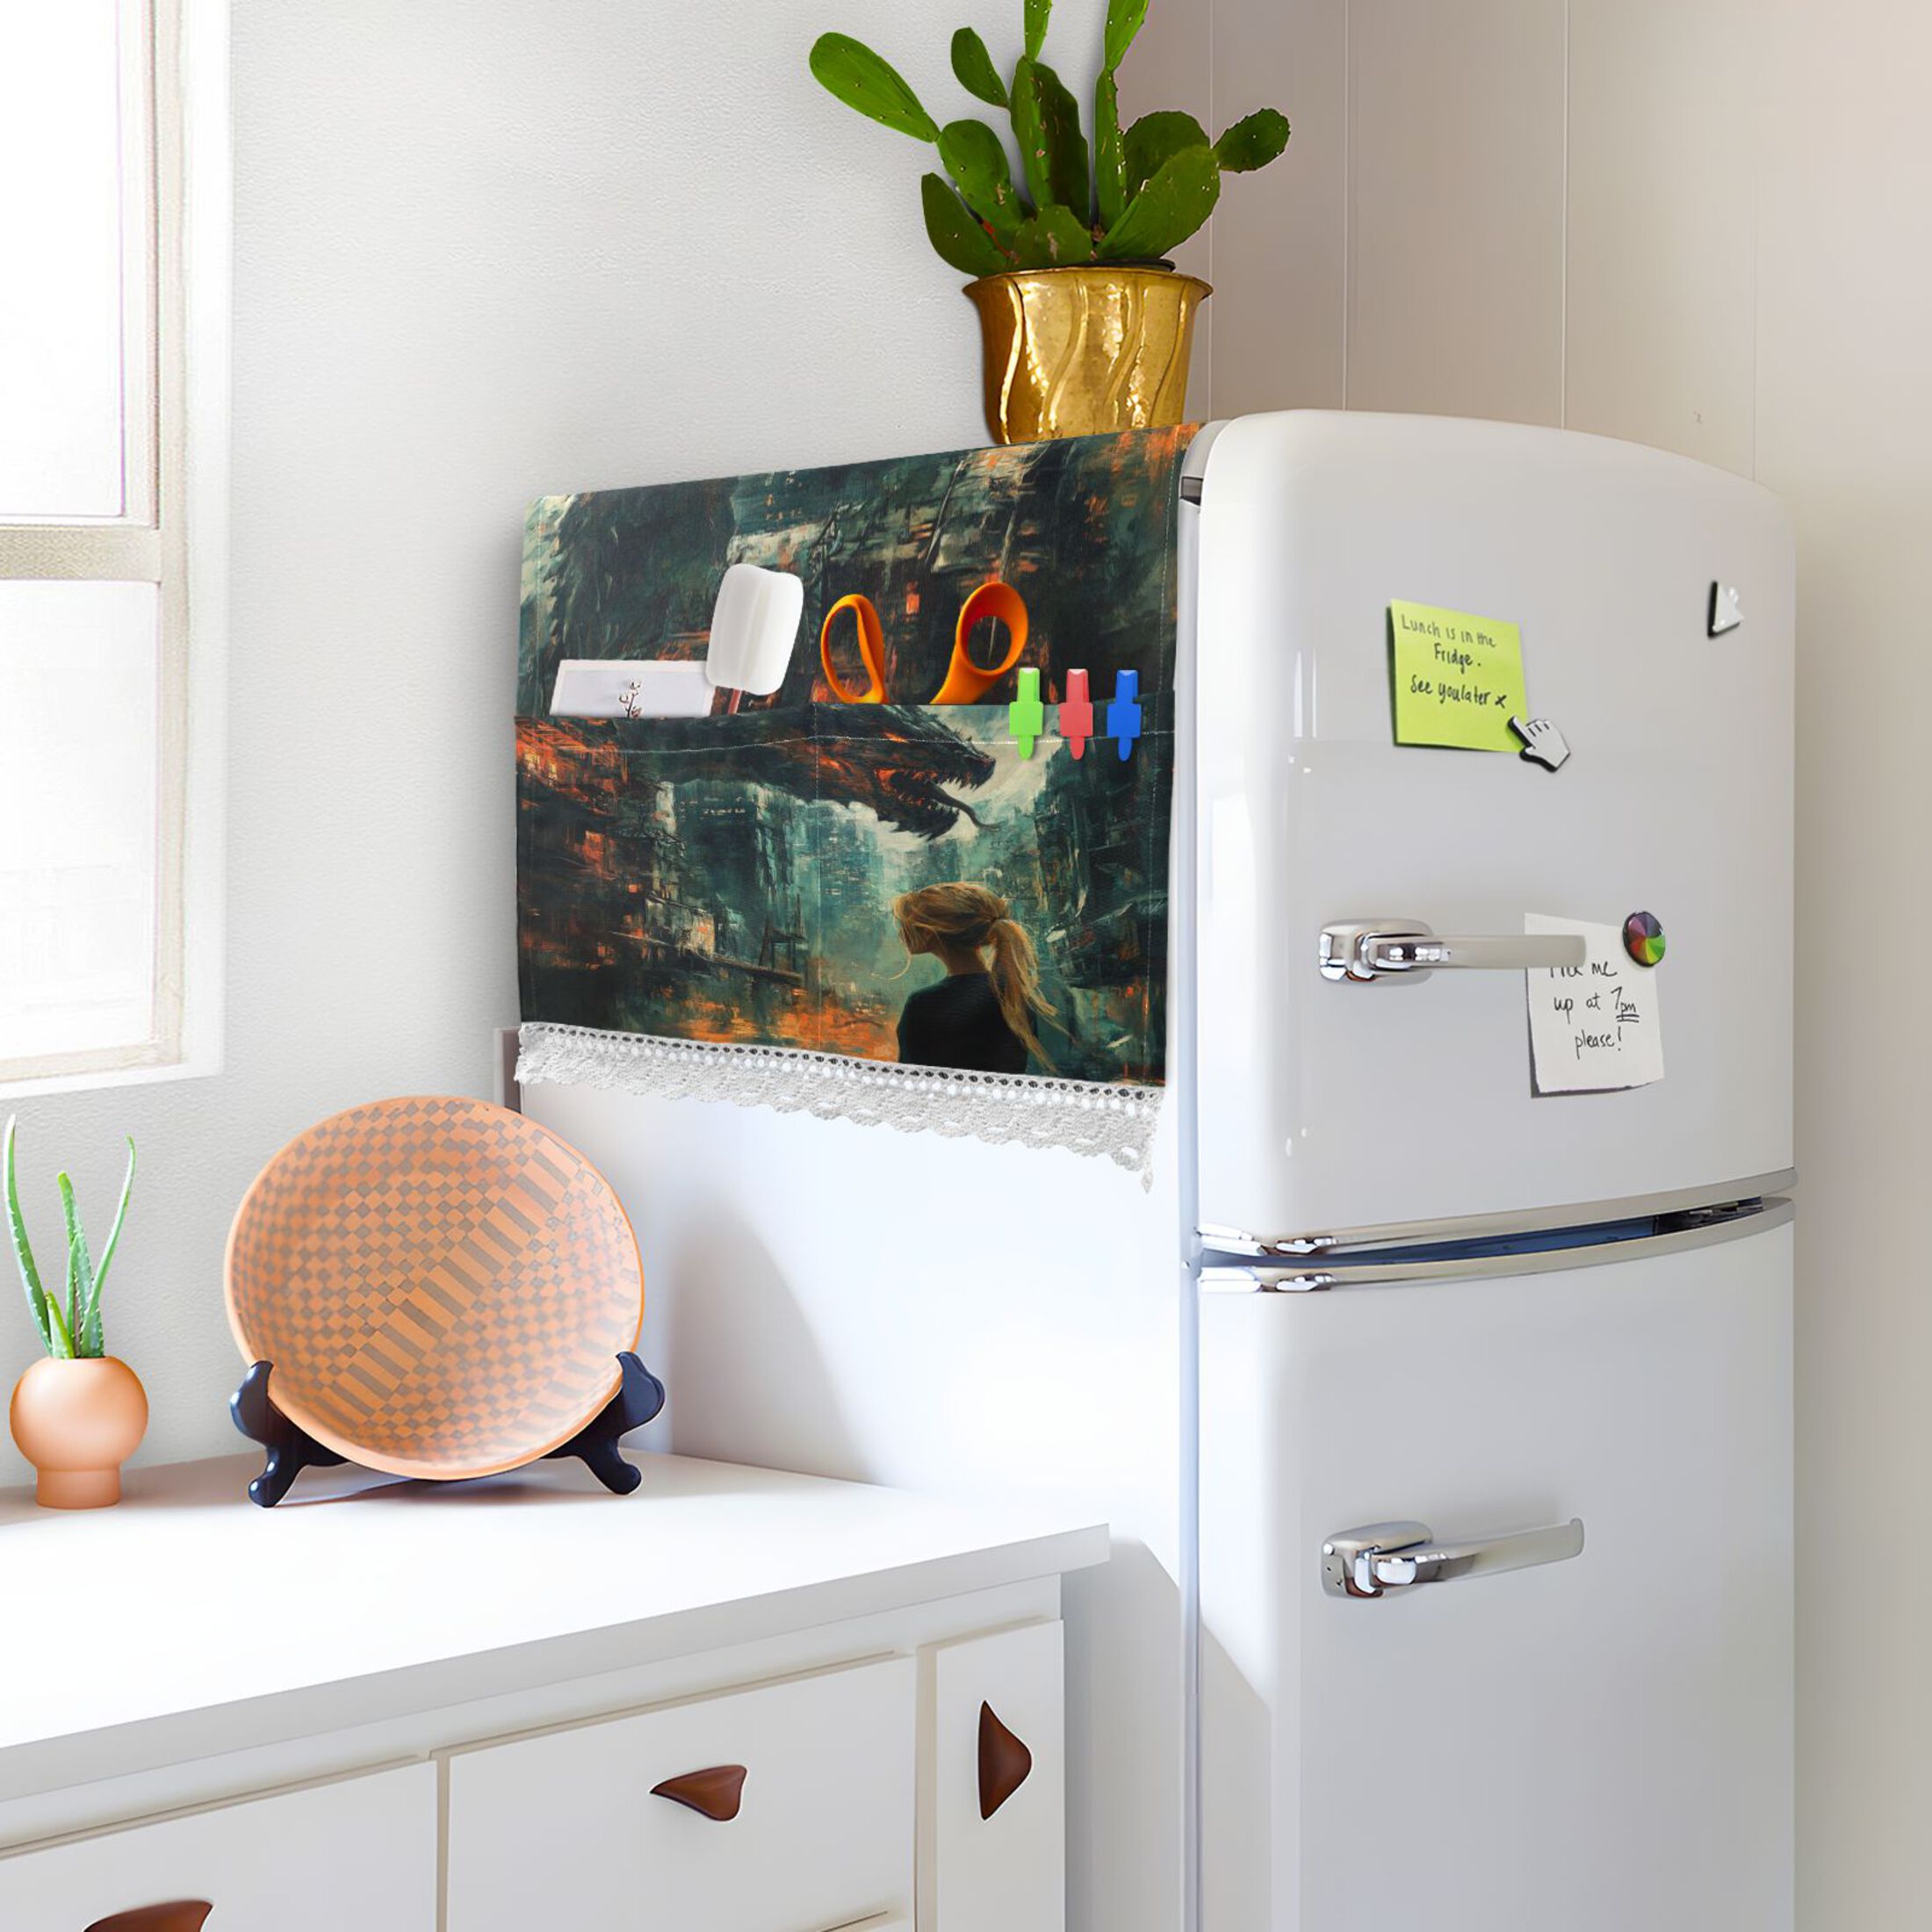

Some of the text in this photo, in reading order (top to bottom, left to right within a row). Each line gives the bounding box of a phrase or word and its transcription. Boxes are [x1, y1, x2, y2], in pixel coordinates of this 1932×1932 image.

[1401, 614, 1440, 638] Lunch
[1476, 631, 1496, 647] the
[1434, 642, 1481, 674] Fridge.
[1410, 674, 1433, 694] See
[1591, 961, 1618, 977] me
[1554, 997, 1574, 1025] up
[1586, 991, 1601, 1011] at
[1575, 1026, 1621, 1060] please!
